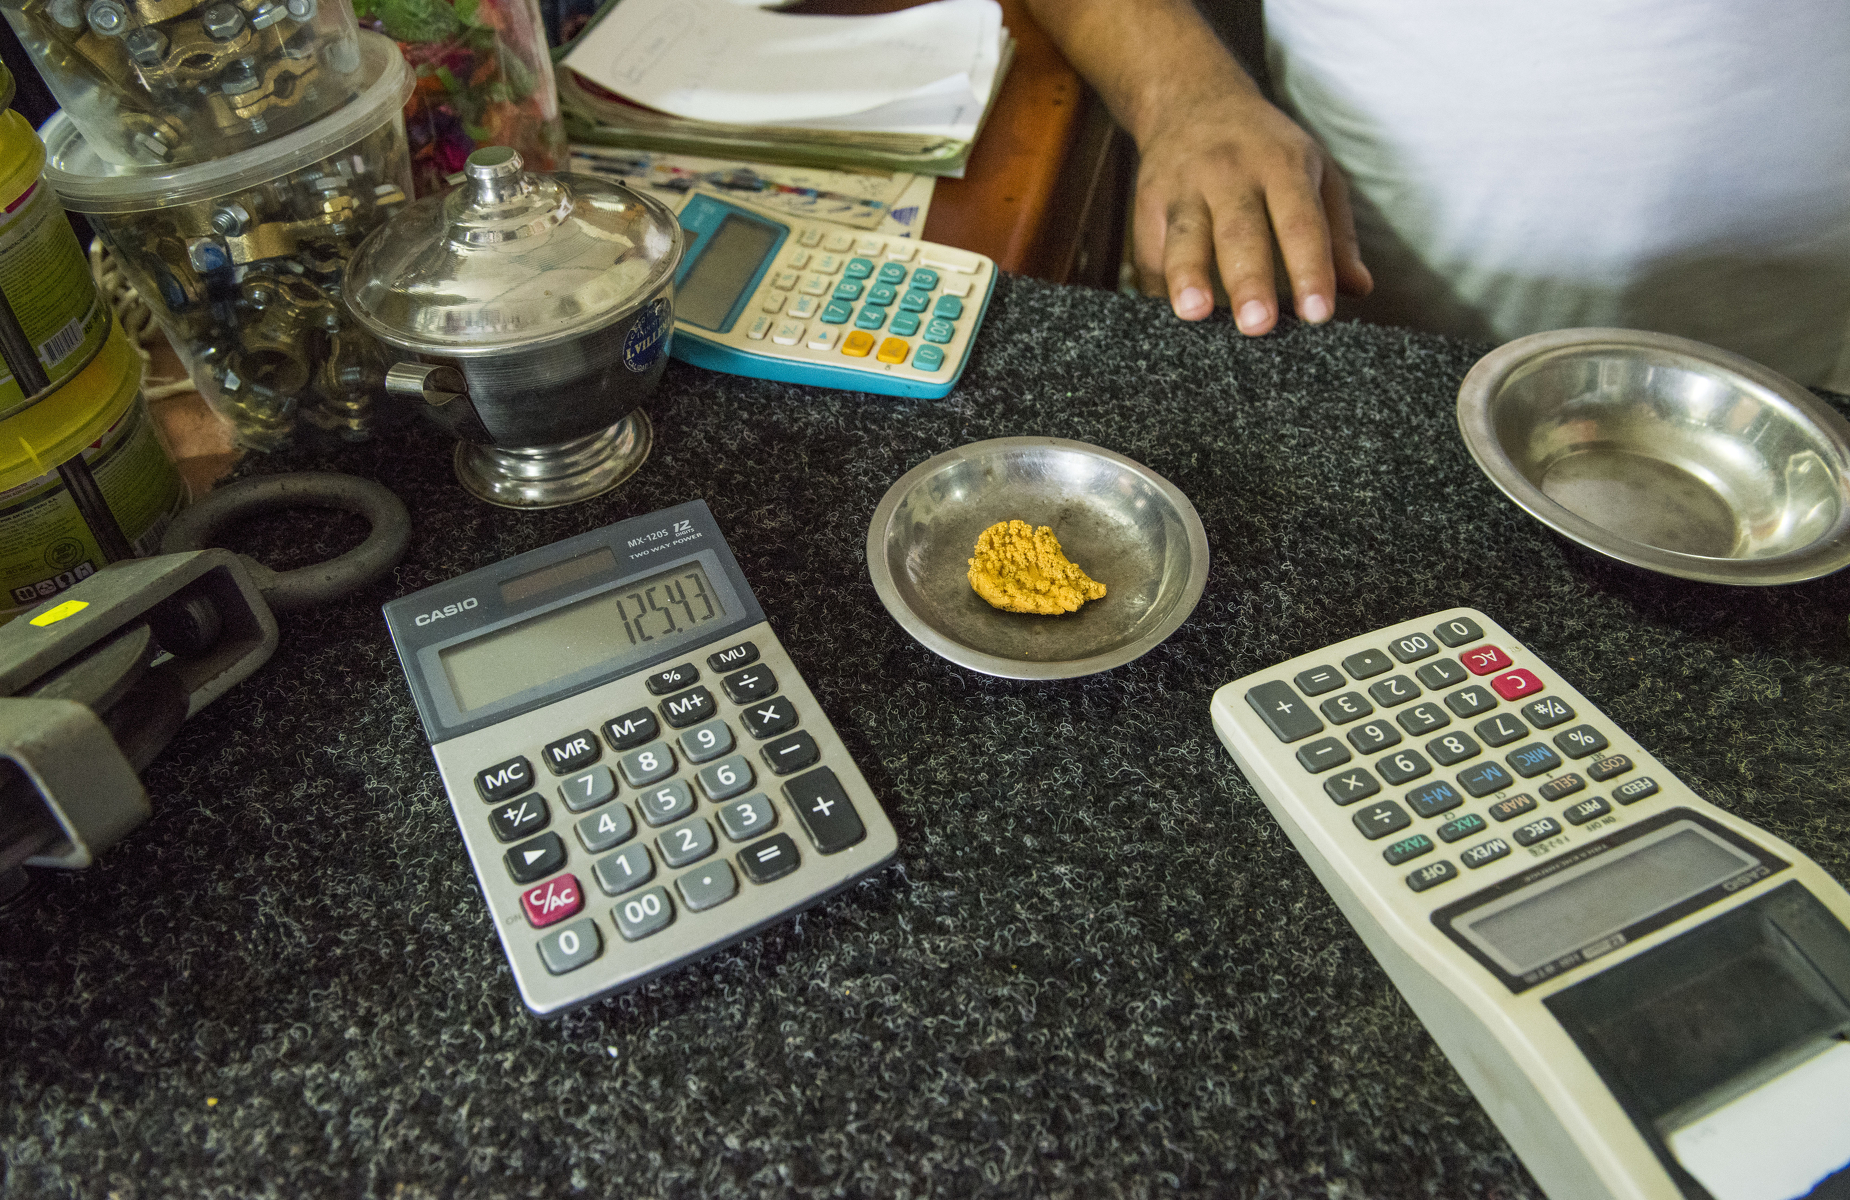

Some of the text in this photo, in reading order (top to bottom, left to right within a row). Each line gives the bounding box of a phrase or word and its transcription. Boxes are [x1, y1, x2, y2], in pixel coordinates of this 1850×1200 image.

[850, 262, 866, 271] 9
[884, 268, 900, 276] 6
[916, 273, 933, 282] 3
[841, 283, 857, 292] 8
[874, 286, 890, 297] 5
[906, 294, 924, 304] 2
[828, 305, 845, 314] 7
[864, 311, 880, 320] 4
[930, 320, 949, 336] 00
[920, 350, 937, 360] 0
[627, 519, 692, 548] MX-120S 12
[675, 528, 695, 537] DIGITS
[629, 532, 703, 560] TWO WAY POWER
[415, 597, 478, 627] CASIO
[1450, 622, 1468, 636] 0
[1400, 635, 1429, 653] 00
[719, 646, 746, 664] MU
[1471, 649, 1498, 667] AC
[1432, 665, 1449, 680] 1
[1383, 680, 1405, 696] 2
[1506, 675, 1526, 690] C
[668, 694, 704, 717] M+
[1337, 696, 1357, 713] 3
[1460, 692, 1478, 707] 4
[1414, 708, 1434, 725] 5
[1495, 718, 1514, 736] 7
[697, 730, 716, 748] 9
[1443, 736, 1465, 753] 8
[552, 737, 590, 762] MR
[1516, 745, 1552, 766] MRC
[639, 752, 658, 771] 8
[1597, 756, 1626, 772] COST
[484, 763, 524, 790] MC
[717, 766, 736, 786] 6
[1550, 775, 1578, 791] SELL
[577, 776, 595, 796] 7
[1422, 785, 1452, 804] M+
[1621, 777, 1653, 795] FEED
[656, 789, 677, 811] 5
[1499, 794, 1530, 813] MAR
[1576, 799, 1602, 816] PRT
[597, 814, 617, 833] 4
[737, 804, 758, 826] 3
[1524, 819, 1553, 838] DEC
[676, 828, 698, 852] 2
[1468, 839, 1507, 861] M/EX
[616, 855, 633, 876] 1
[1420, 863, 1446, 881] OFF
[1722, 865, 1770, 892] CASIO
[529, 883, 575, 914] C/AC
[624, 893, 661, 925] 00
[558, 930, 581, 955] 0
